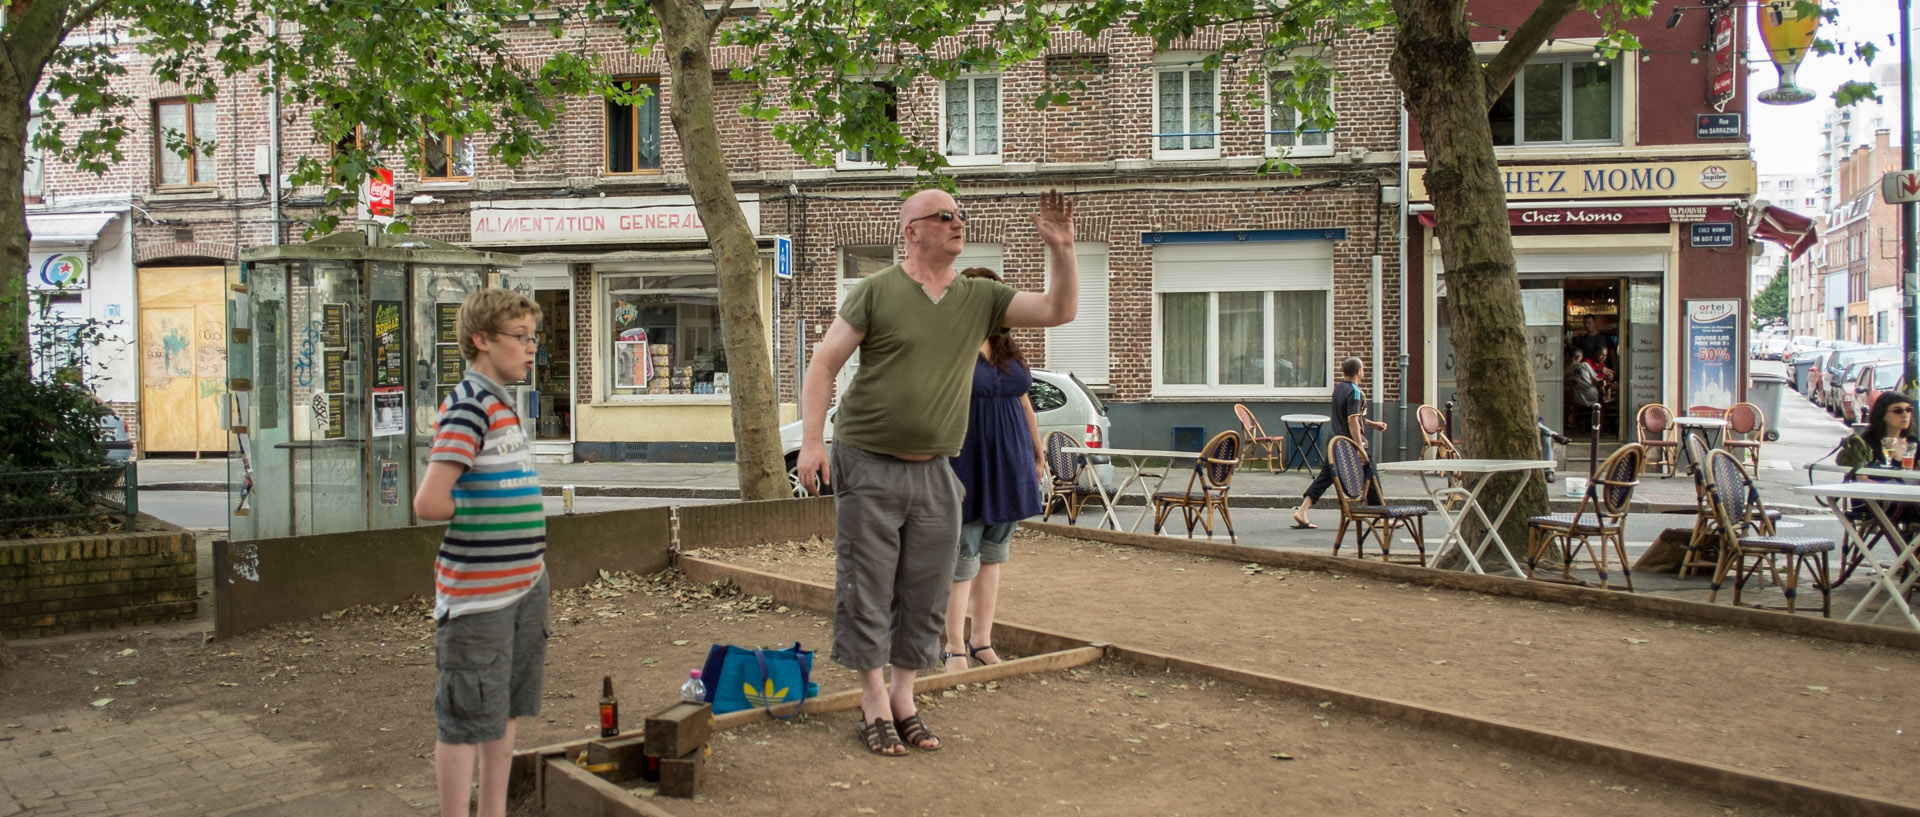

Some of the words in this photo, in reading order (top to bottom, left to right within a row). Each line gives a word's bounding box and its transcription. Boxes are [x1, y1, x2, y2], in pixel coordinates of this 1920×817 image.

[1503, 170, 1567, 194] HEZ
[1583, 167, 1676, 191] MOMO
[475, 216, 605, 232] ALIMENTATION
[619, 213, 704, 231] GENERAL
[1521, 210, 1561, 223] Chez
[1566, 210, 1623, 223] Momo
[1699, 303, 1725, 311] ortel
[1694, 347, 1731, 362] -50%
